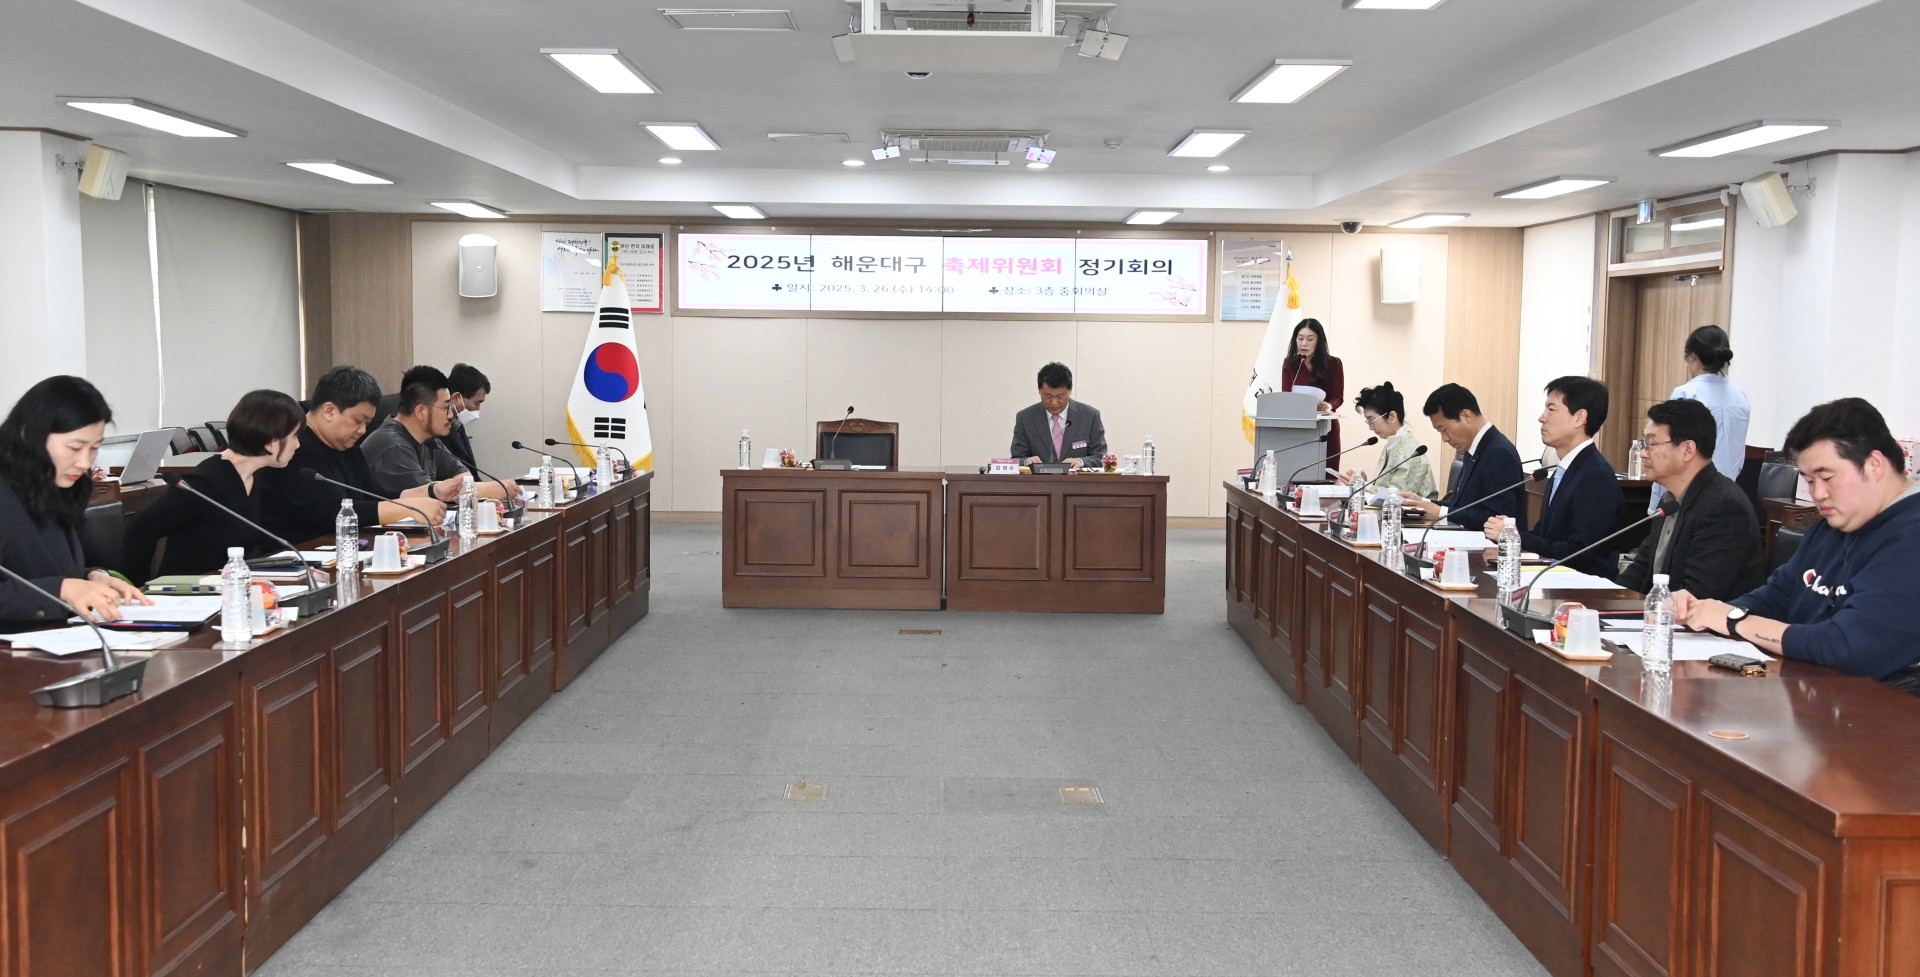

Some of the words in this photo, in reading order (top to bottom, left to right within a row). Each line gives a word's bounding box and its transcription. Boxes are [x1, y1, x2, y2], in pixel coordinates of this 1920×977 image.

[727, 255, 815, 272] 2025년
[831, 255, 927, 274] 해운대구
[943, 257, 1062, 275] 축제위원회
[1079, 258, 1173, 276] 정기회의
[918, 285, 955, 294] 14:00
[1036, 286, 1054, 296] 3층
[1059, 286, 1107, 297] 중회의실
